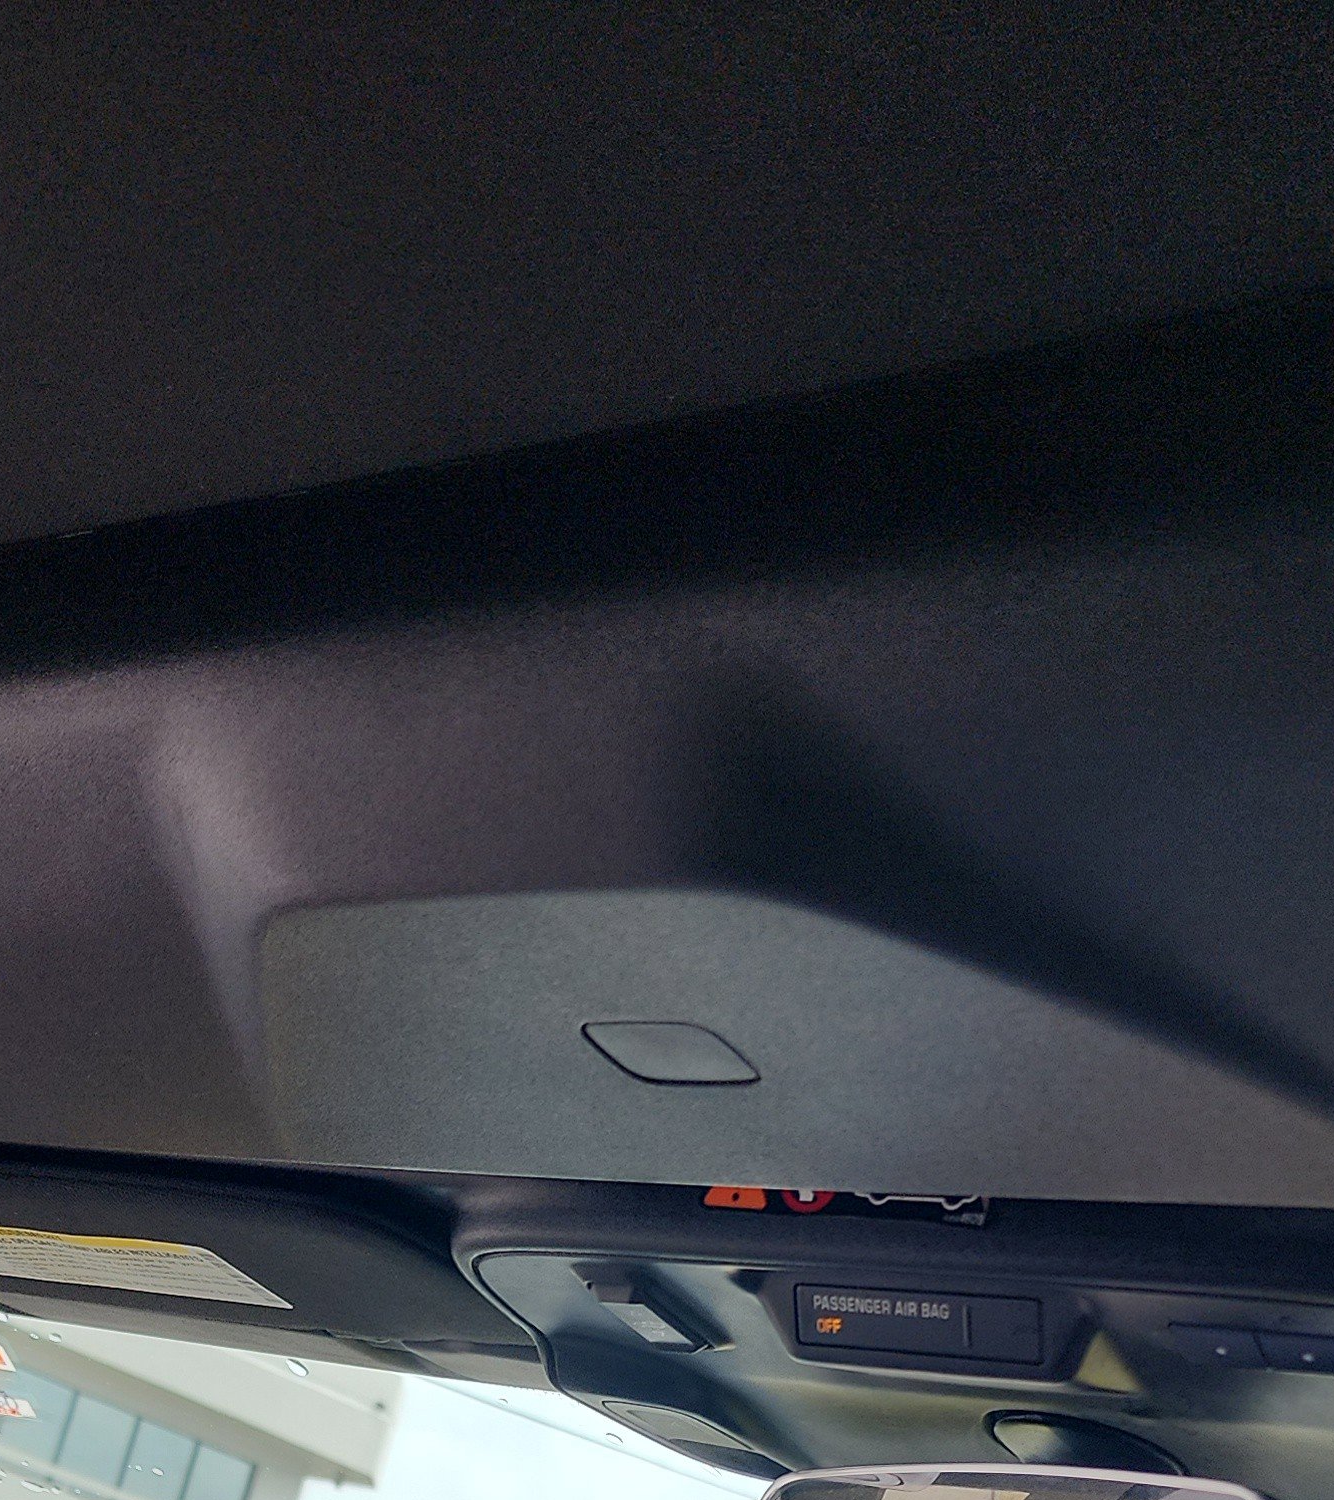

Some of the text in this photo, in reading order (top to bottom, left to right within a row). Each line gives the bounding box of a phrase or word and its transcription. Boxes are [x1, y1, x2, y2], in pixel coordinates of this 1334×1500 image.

[812, 1294, 950, 1320] PASSENGER AIR BAG
[815, 1317, 842, 1334] OFF
